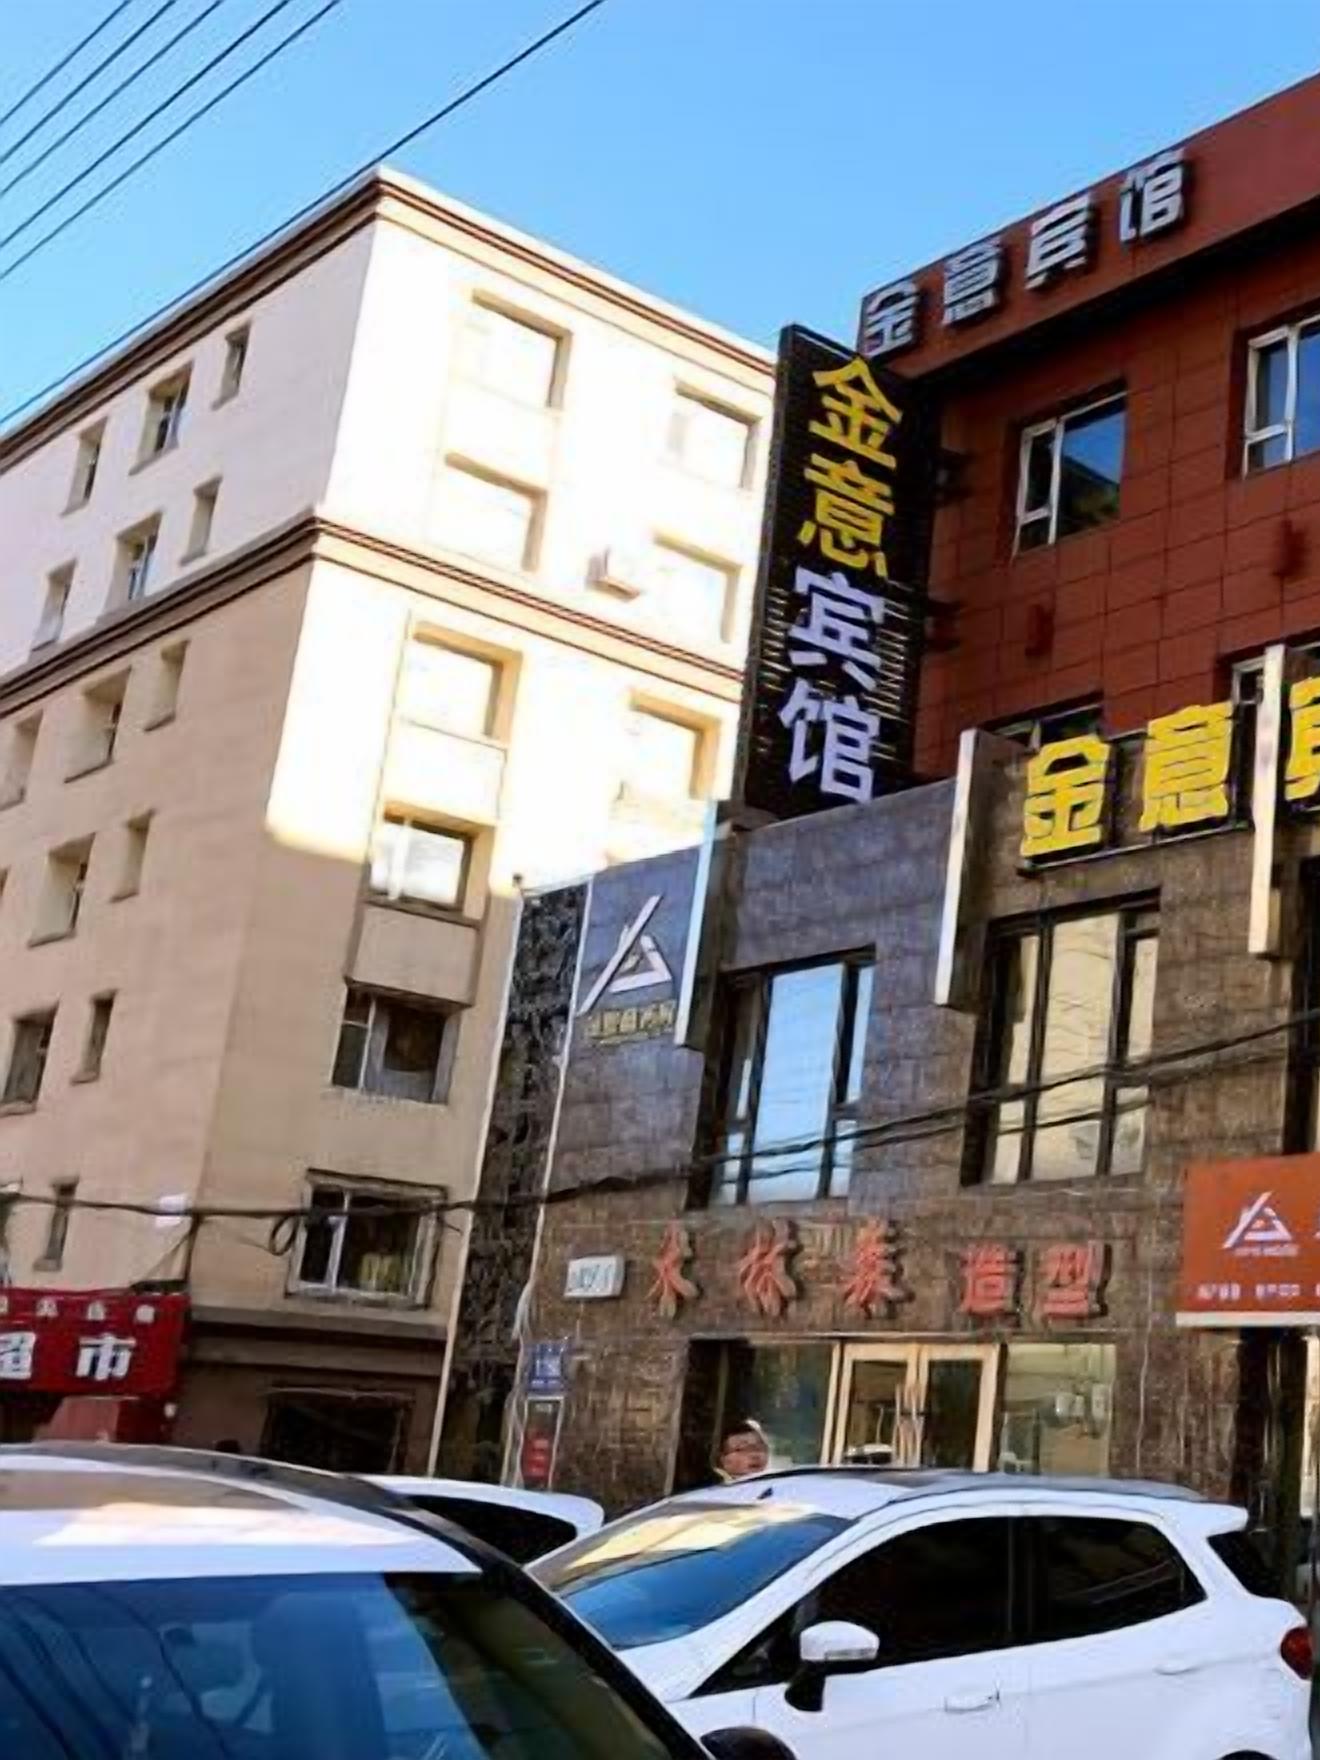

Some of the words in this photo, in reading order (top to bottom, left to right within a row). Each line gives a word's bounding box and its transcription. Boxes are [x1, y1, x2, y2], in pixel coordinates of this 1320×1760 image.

[866, 149, 1187, 357] 金意宾馆
[778, 356, 903, 806] 金意宾馆
